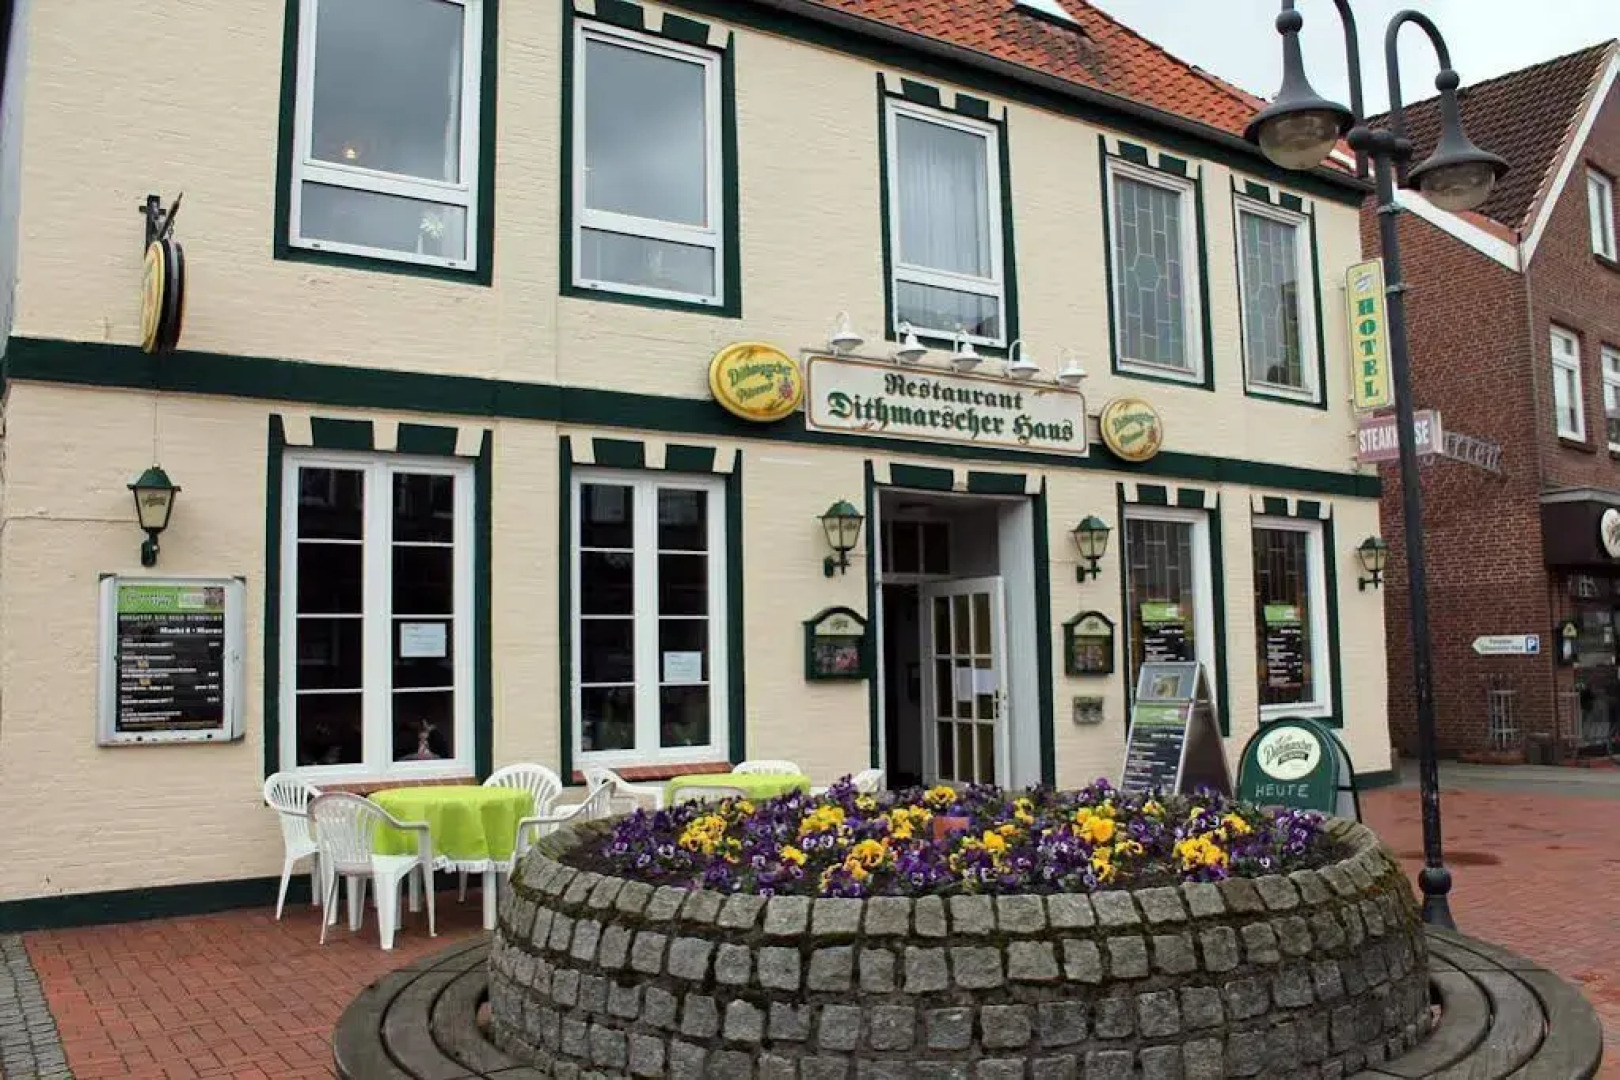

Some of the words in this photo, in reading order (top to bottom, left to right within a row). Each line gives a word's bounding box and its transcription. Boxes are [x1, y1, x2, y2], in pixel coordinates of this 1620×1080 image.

[1356, 297, 1380, 399] HOTEL
[884, 373, 1022, 410] Restaurant
[827, 391, 1004, 440] Dithmarscher
[1012, 414, 1074, 444] Haus
[1359, 419, 1429, 454] STEAKSE
[1527, 639, 1537, 651] P
[1255, 783, 1309, 798] HEUTE
